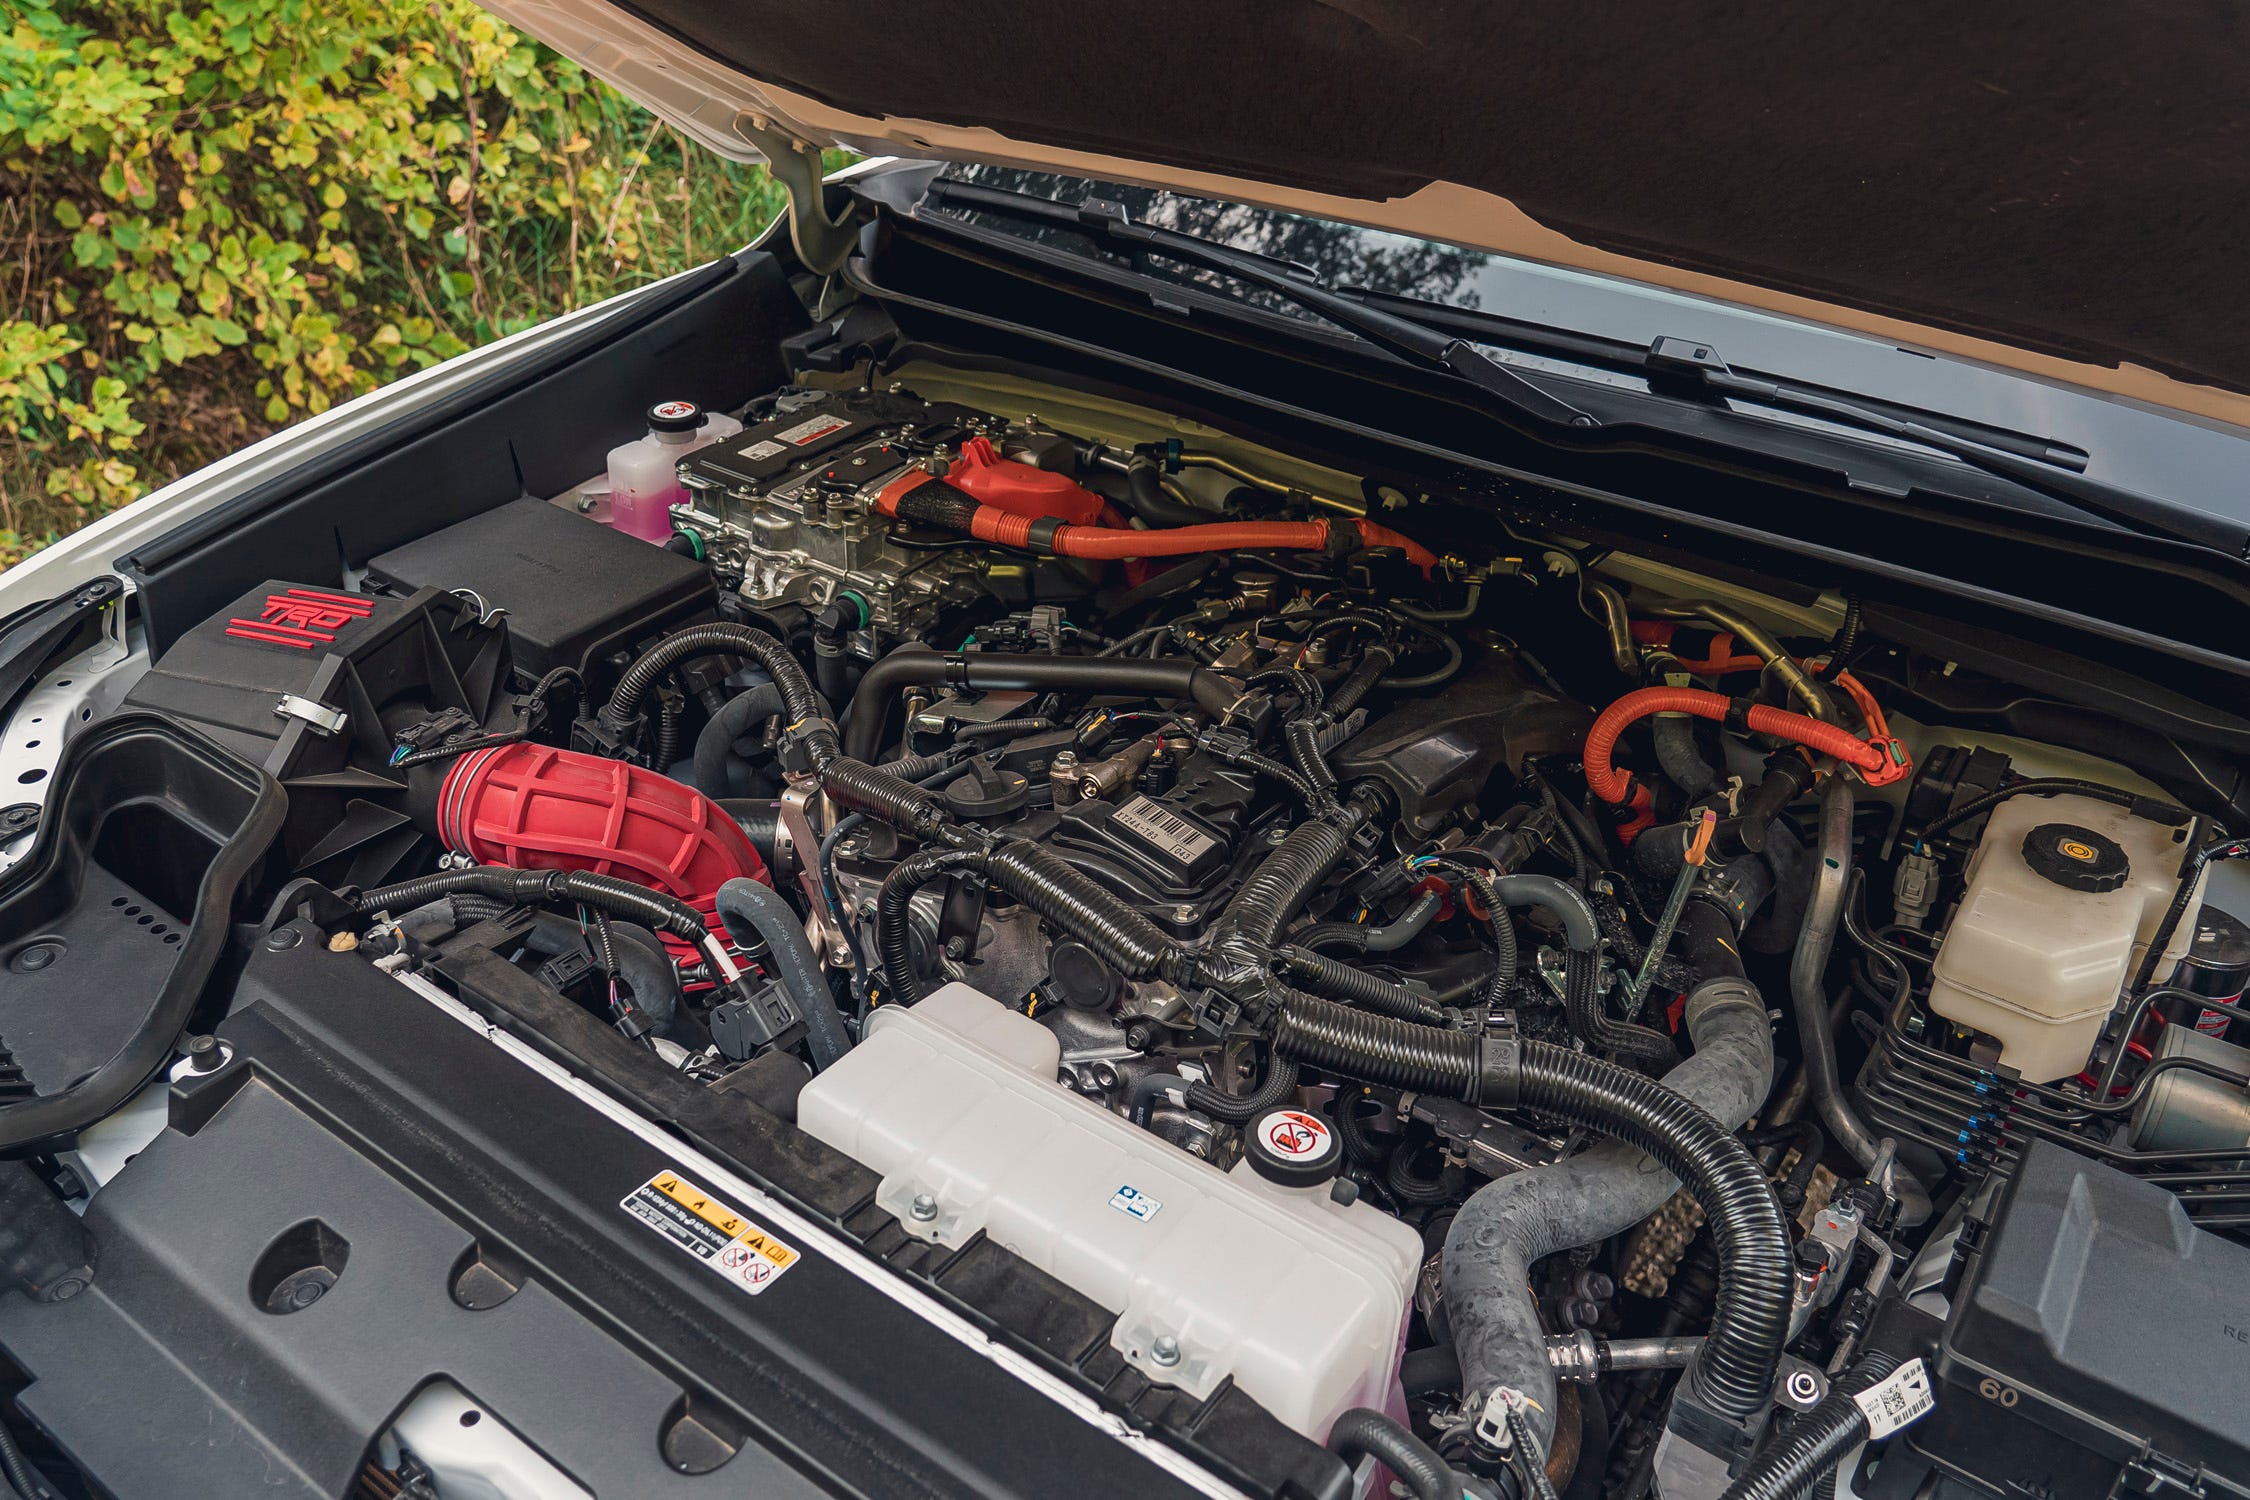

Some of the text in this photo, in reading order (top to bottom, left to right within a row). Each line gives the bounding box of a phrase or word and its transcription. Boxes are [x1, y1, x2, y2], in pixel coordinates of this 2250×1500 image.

[260, 602, 352, 630] TRD
[1174, 847, 1191, 860] 043
[1491, 1047, 1511, 1066] 29
[1979, 1378, 2019, 1408] 60
